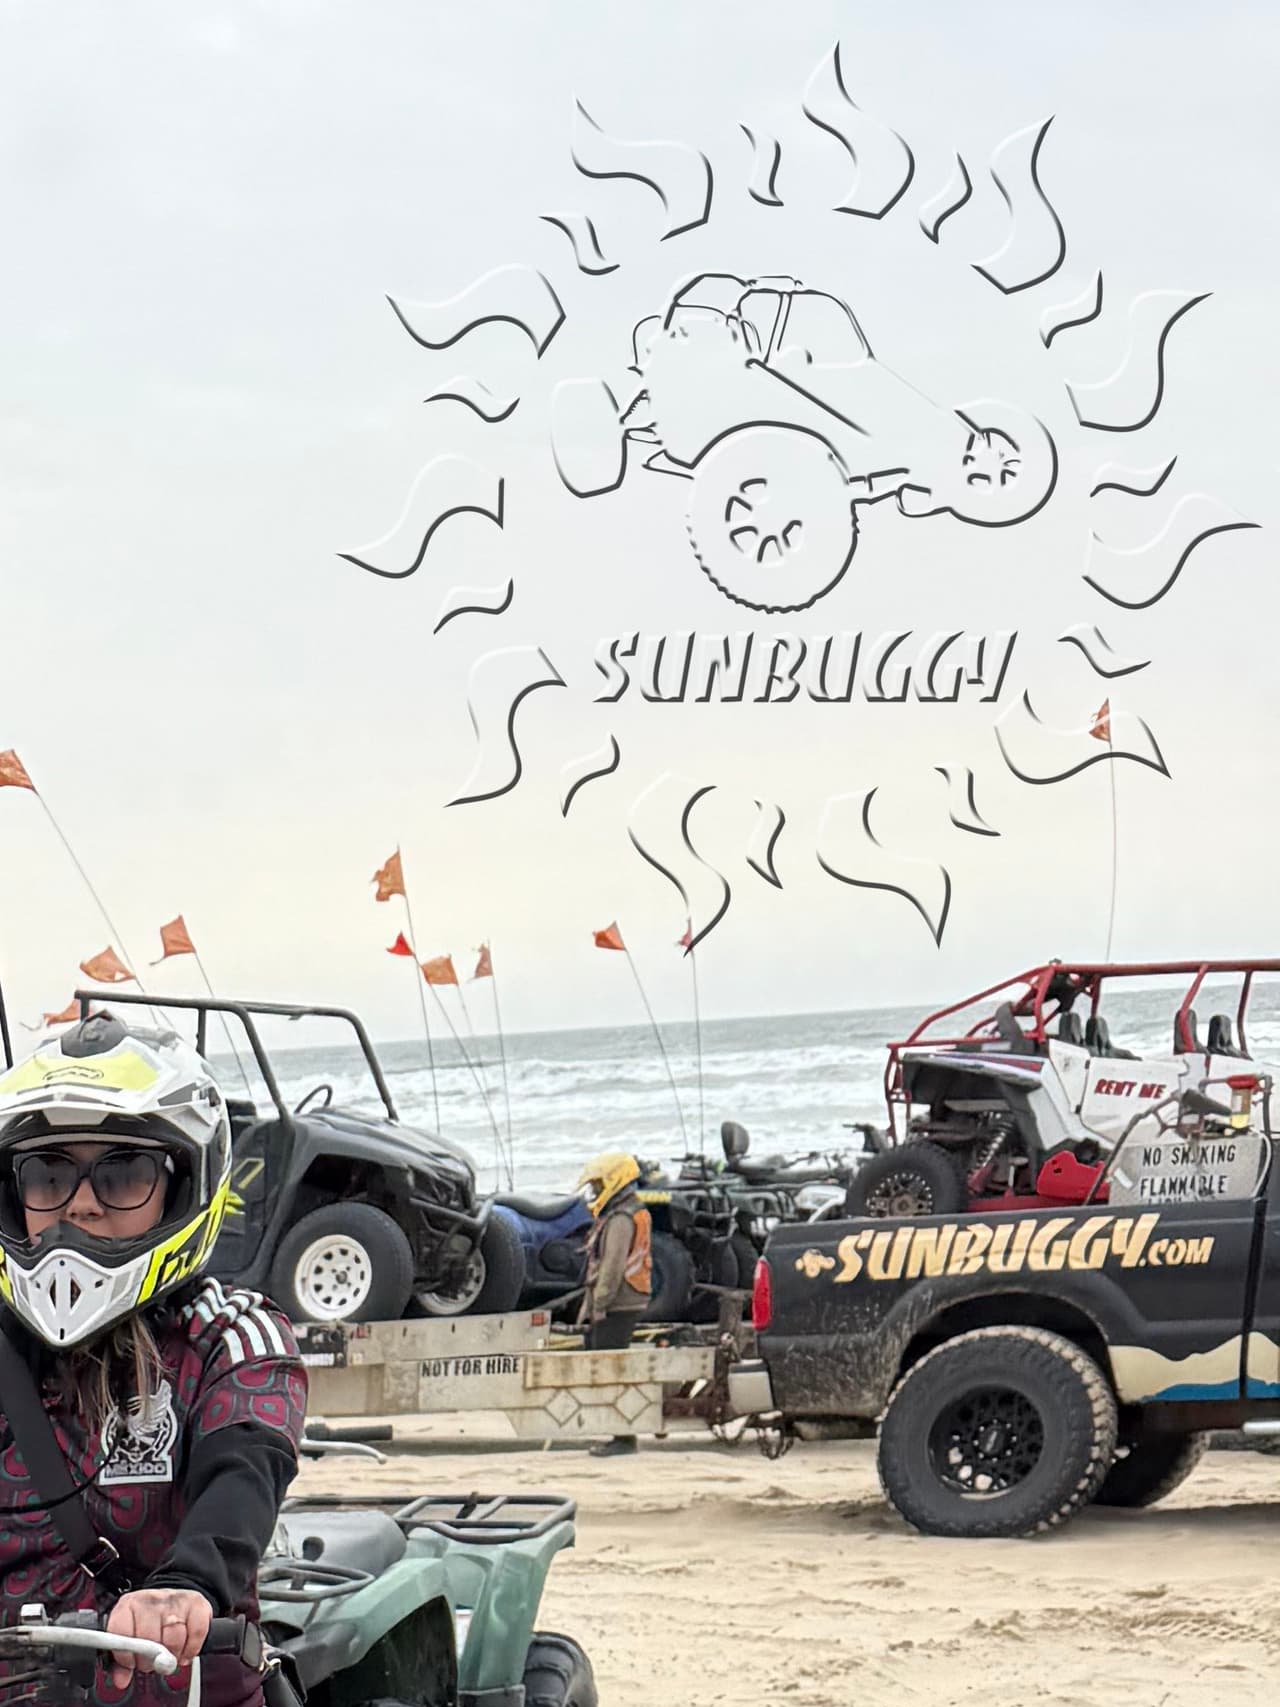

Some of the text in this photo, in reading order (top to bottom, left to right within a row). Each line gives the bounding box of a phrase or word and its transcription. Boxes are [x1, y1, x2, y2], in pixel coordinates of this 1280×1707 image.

[1094, 1078, 1167, 1099] RENT ME
[1142, 1144, 1237, 1167] NO SMKING
[421, 1355, 520, 1377] NOT FOR HIRE
